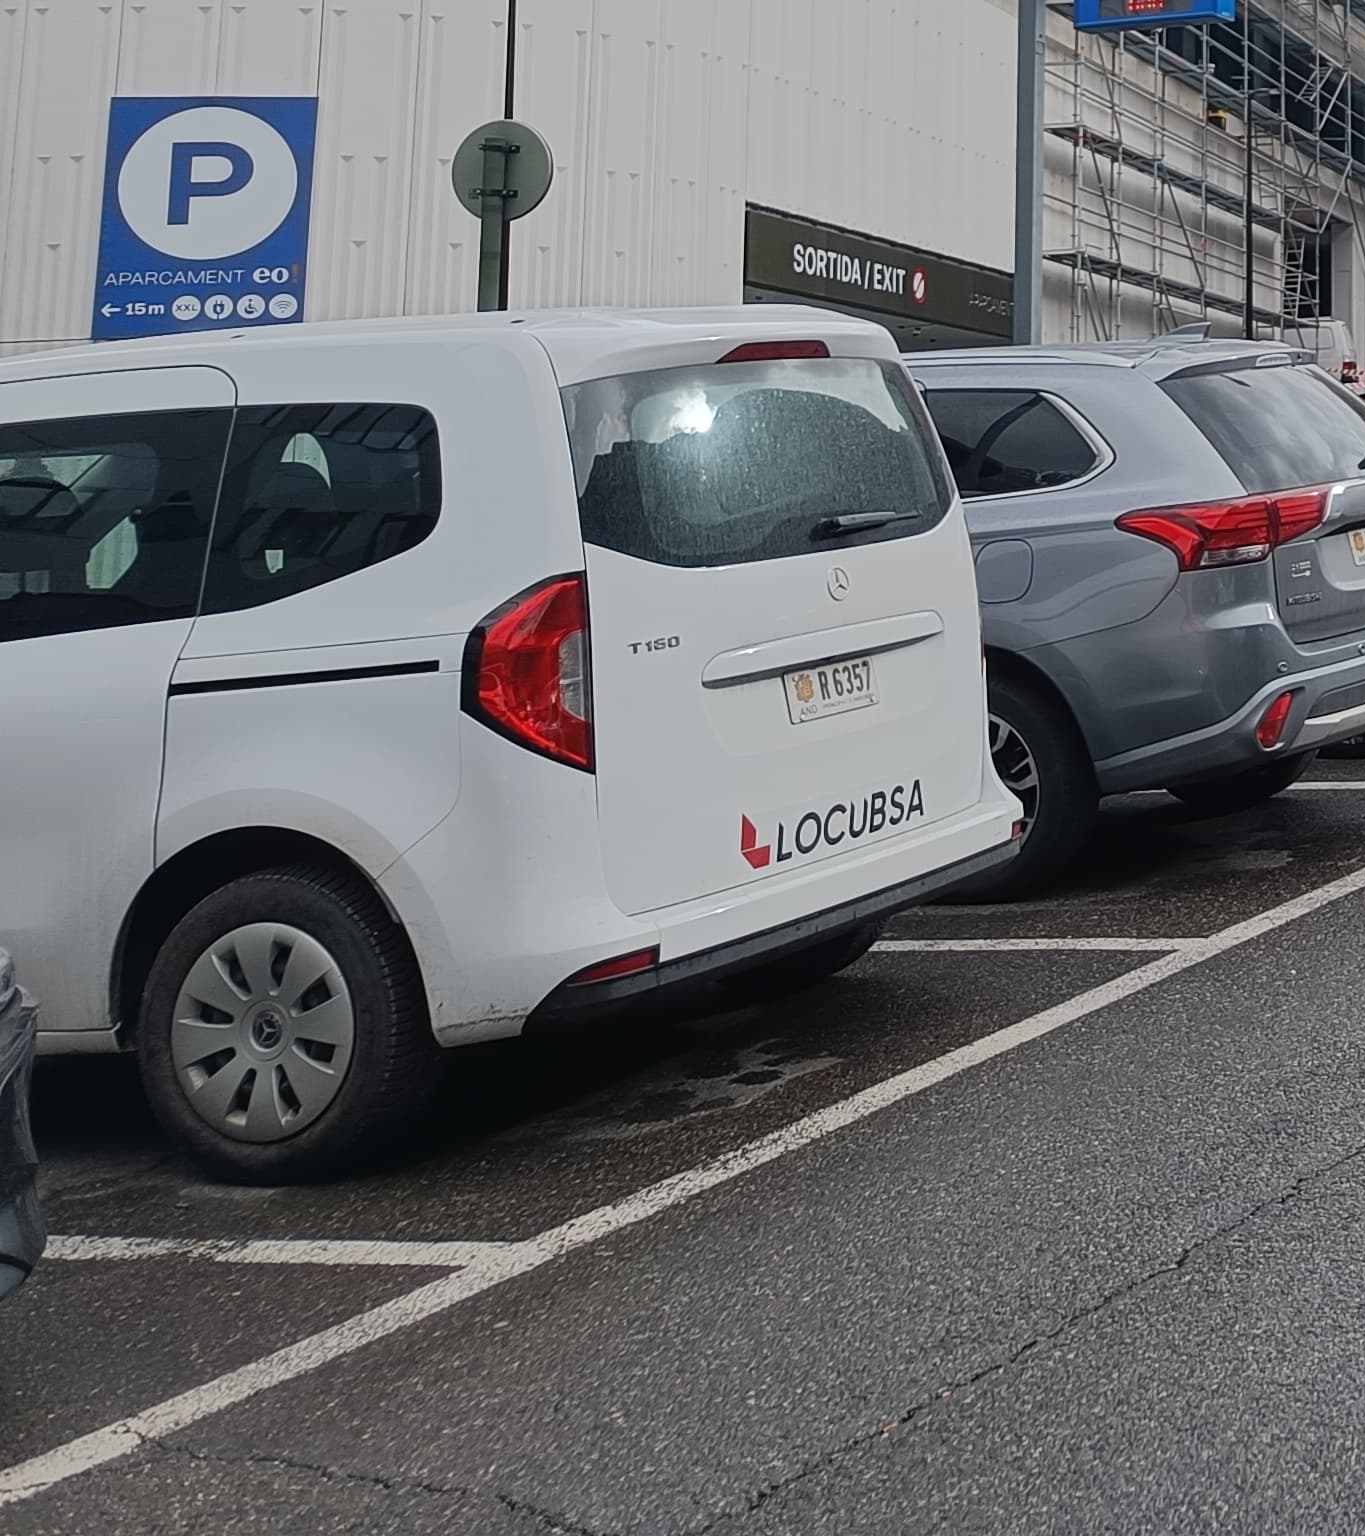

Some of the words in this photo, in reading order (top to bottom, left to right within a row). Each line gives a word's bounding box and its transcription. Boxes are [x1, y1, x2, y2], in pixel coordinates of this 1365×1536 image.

[166, 141, 255, 226] P
[103, 269, 246, 287] APARCAMENT
[793, 243, 862, 287] SORTIDA
[873, 264, 906, 295] EXIT
[174, 303, 198, 313] XXL
[776, 778, 925, 864] LOCUBSA
